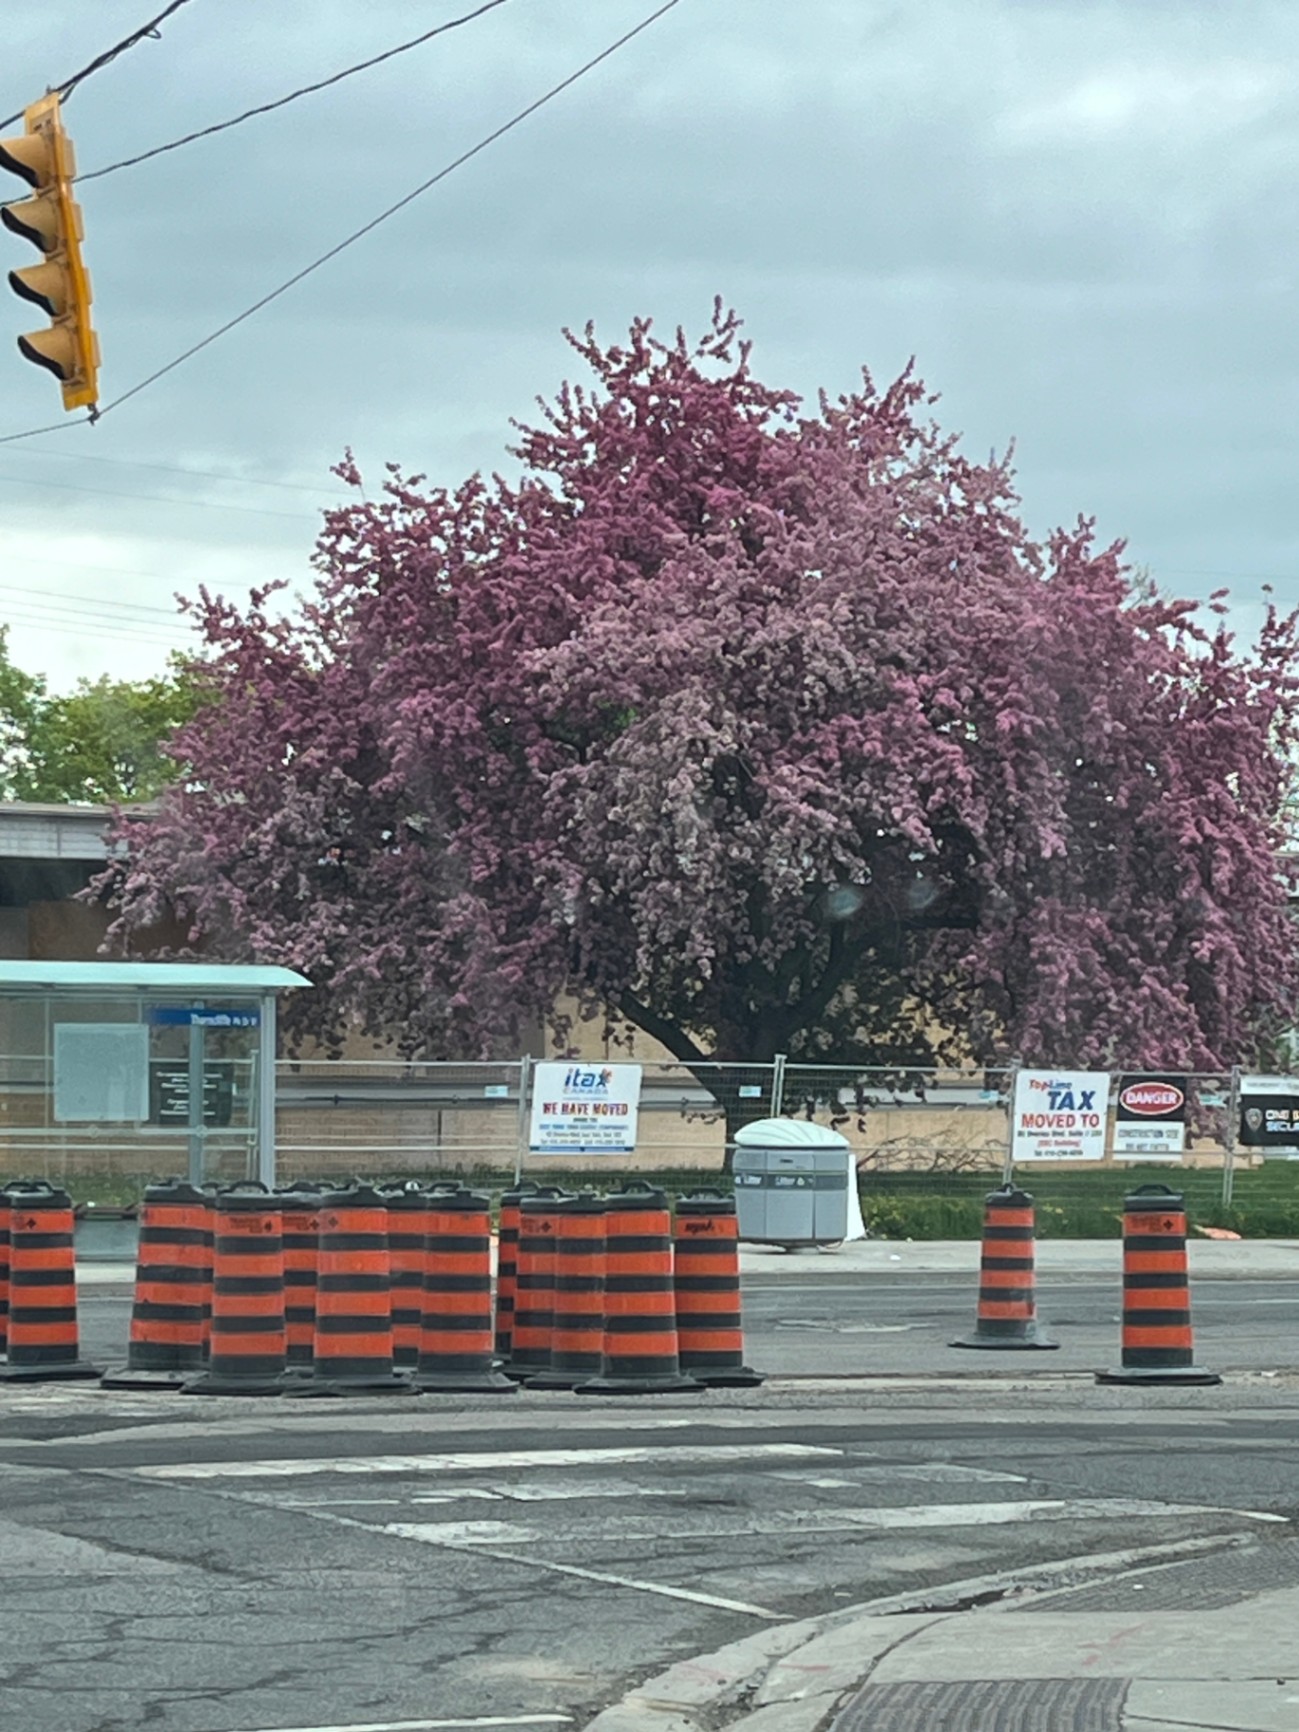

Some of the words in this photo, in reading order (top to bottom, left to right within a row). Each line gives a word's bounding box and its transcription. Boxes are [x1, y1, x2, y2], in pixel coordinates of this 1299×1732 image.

[1047, 1090, 1096, 1111] TAX
[1126, 1091, 1178, 1105] DANGER
[543, 1103, 558, 1115] WE
[561, 1103, 589, 1115] HAVE
[593, 1103, 628, 1116] MOVED
[1021, 1113, 1076, 1128] MOVED
[1080, 1114, 1100, 1128] TO
